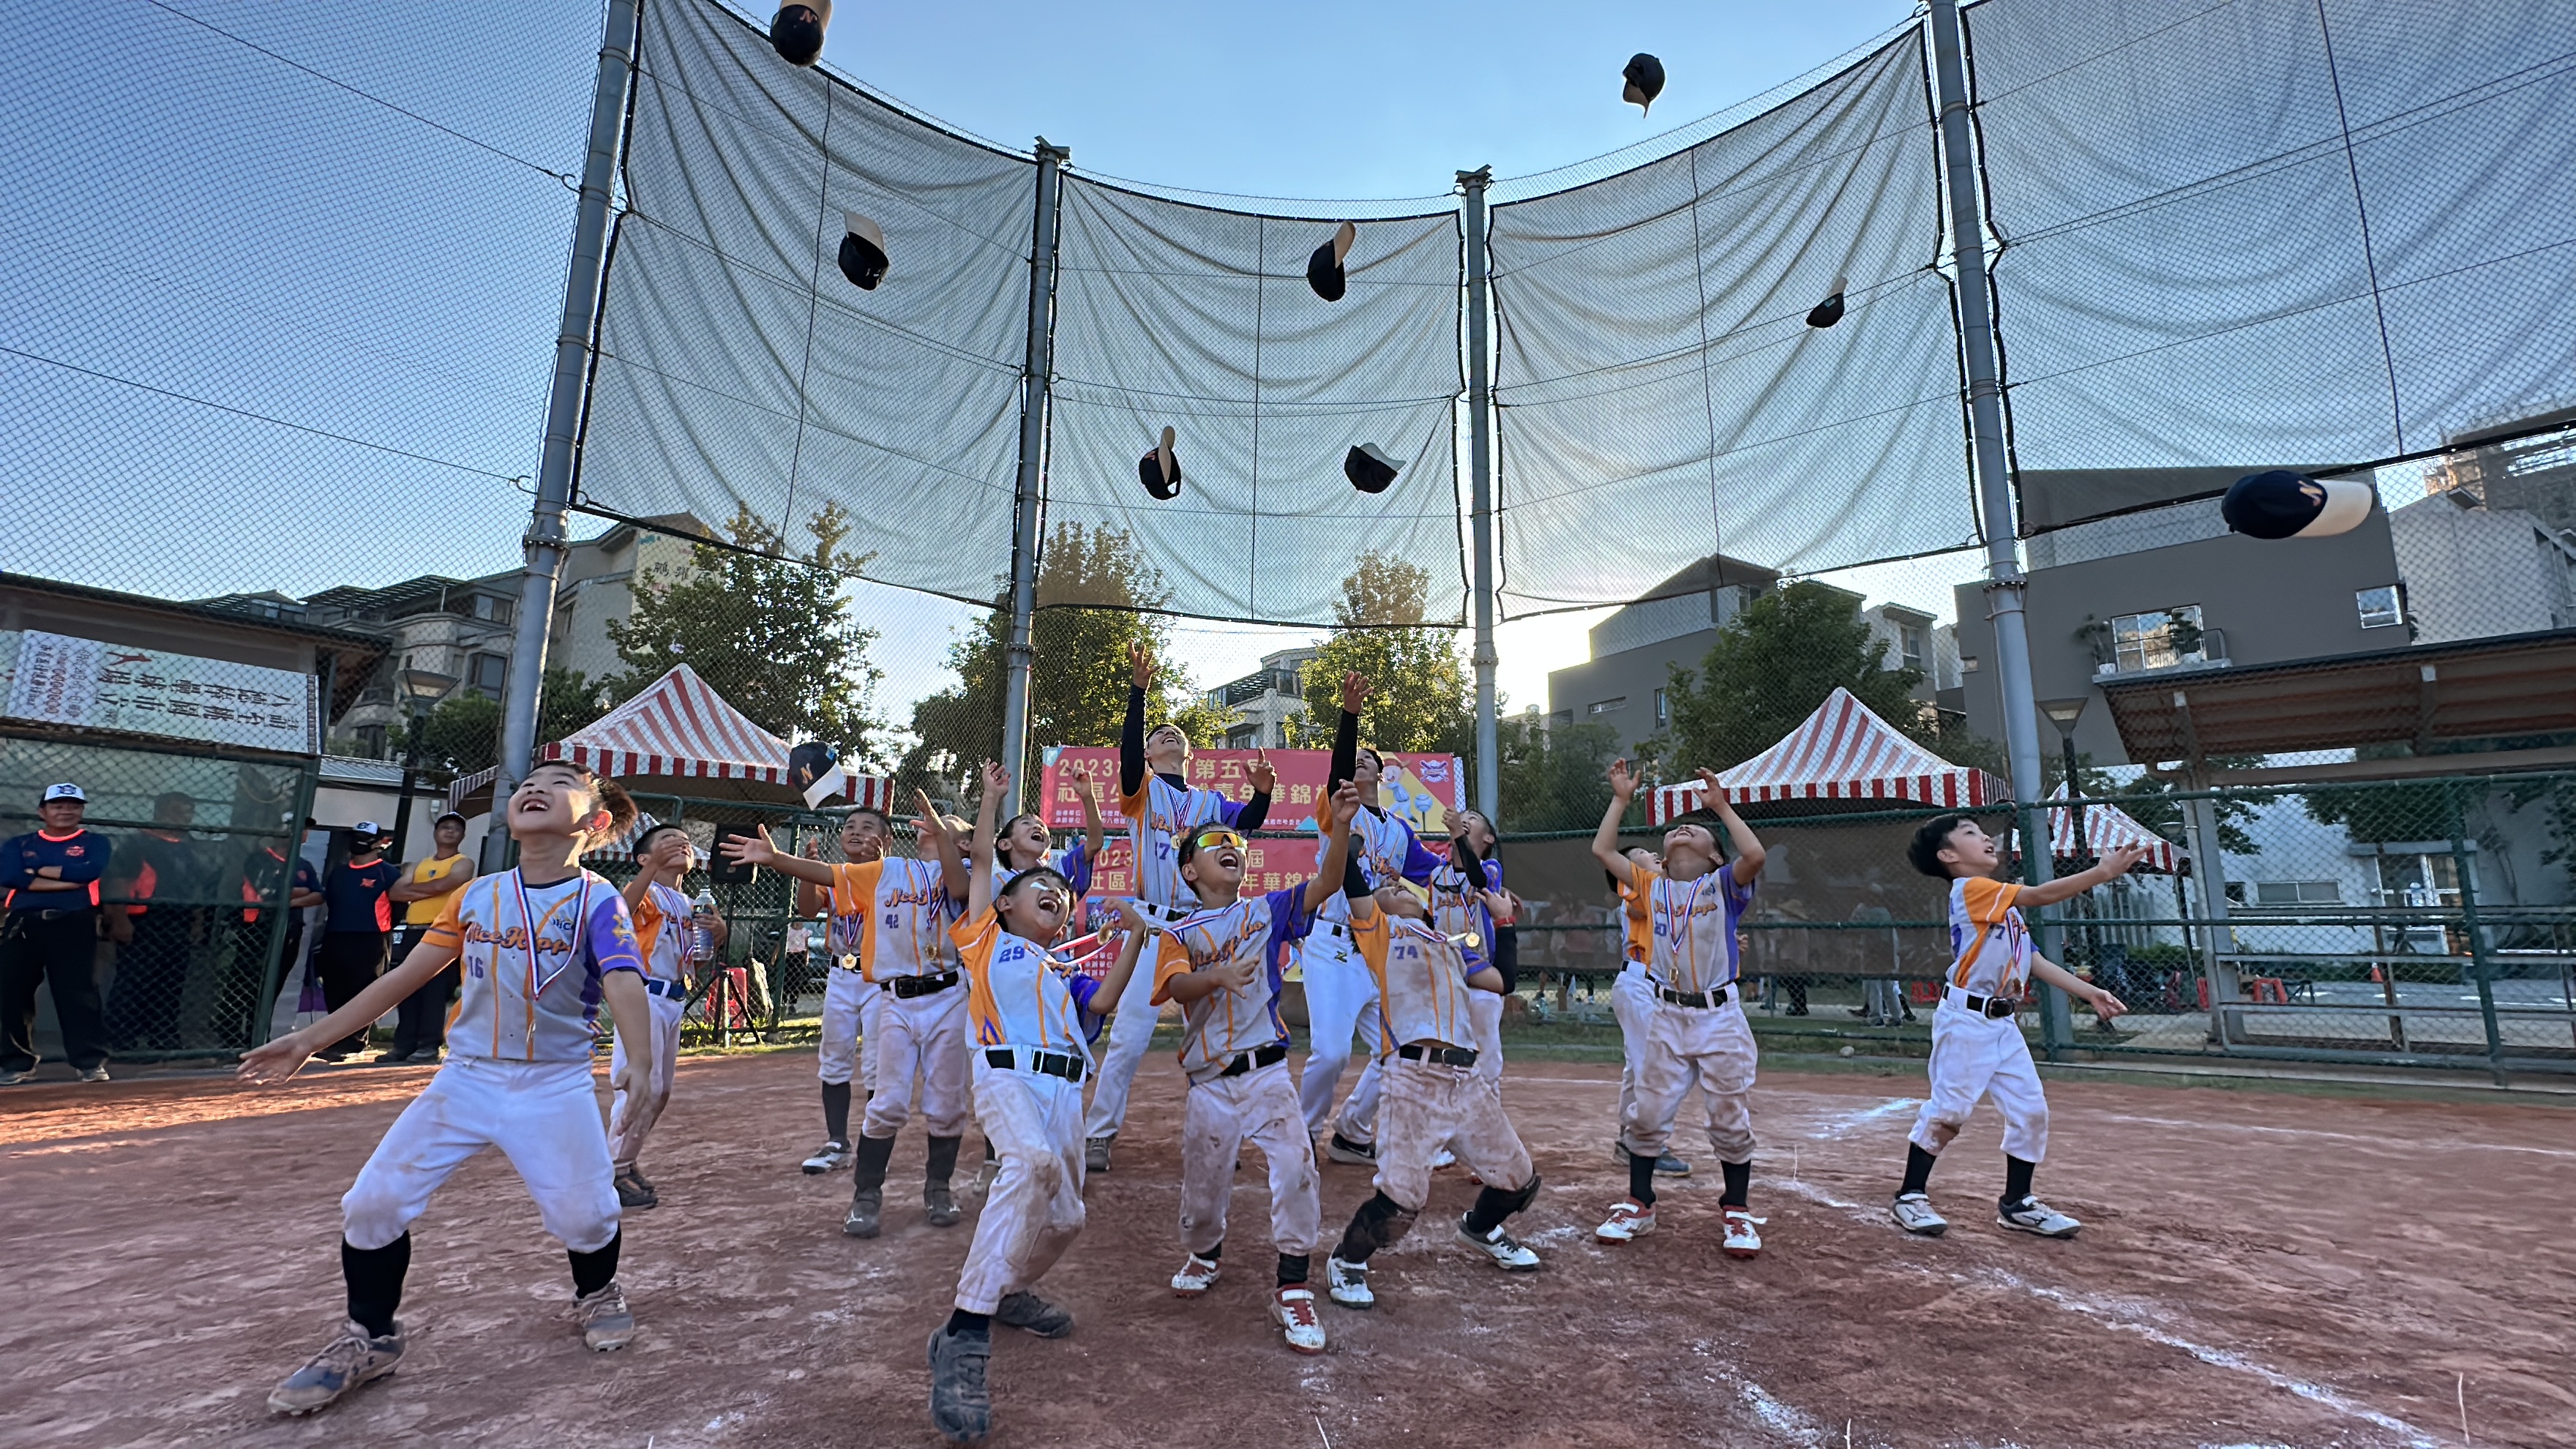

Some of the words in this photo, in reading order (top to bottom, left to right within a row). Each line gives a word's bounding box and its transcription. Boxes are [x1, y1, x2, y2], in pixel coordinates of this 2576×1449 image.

[1247, 849, 1264, 868] 屆
[885, 914, 899, 929] 42
[998, 946, 1025, 963] 29
[1394, 945, 1418, 960] 74
[468, 956, 484, 979] 16
